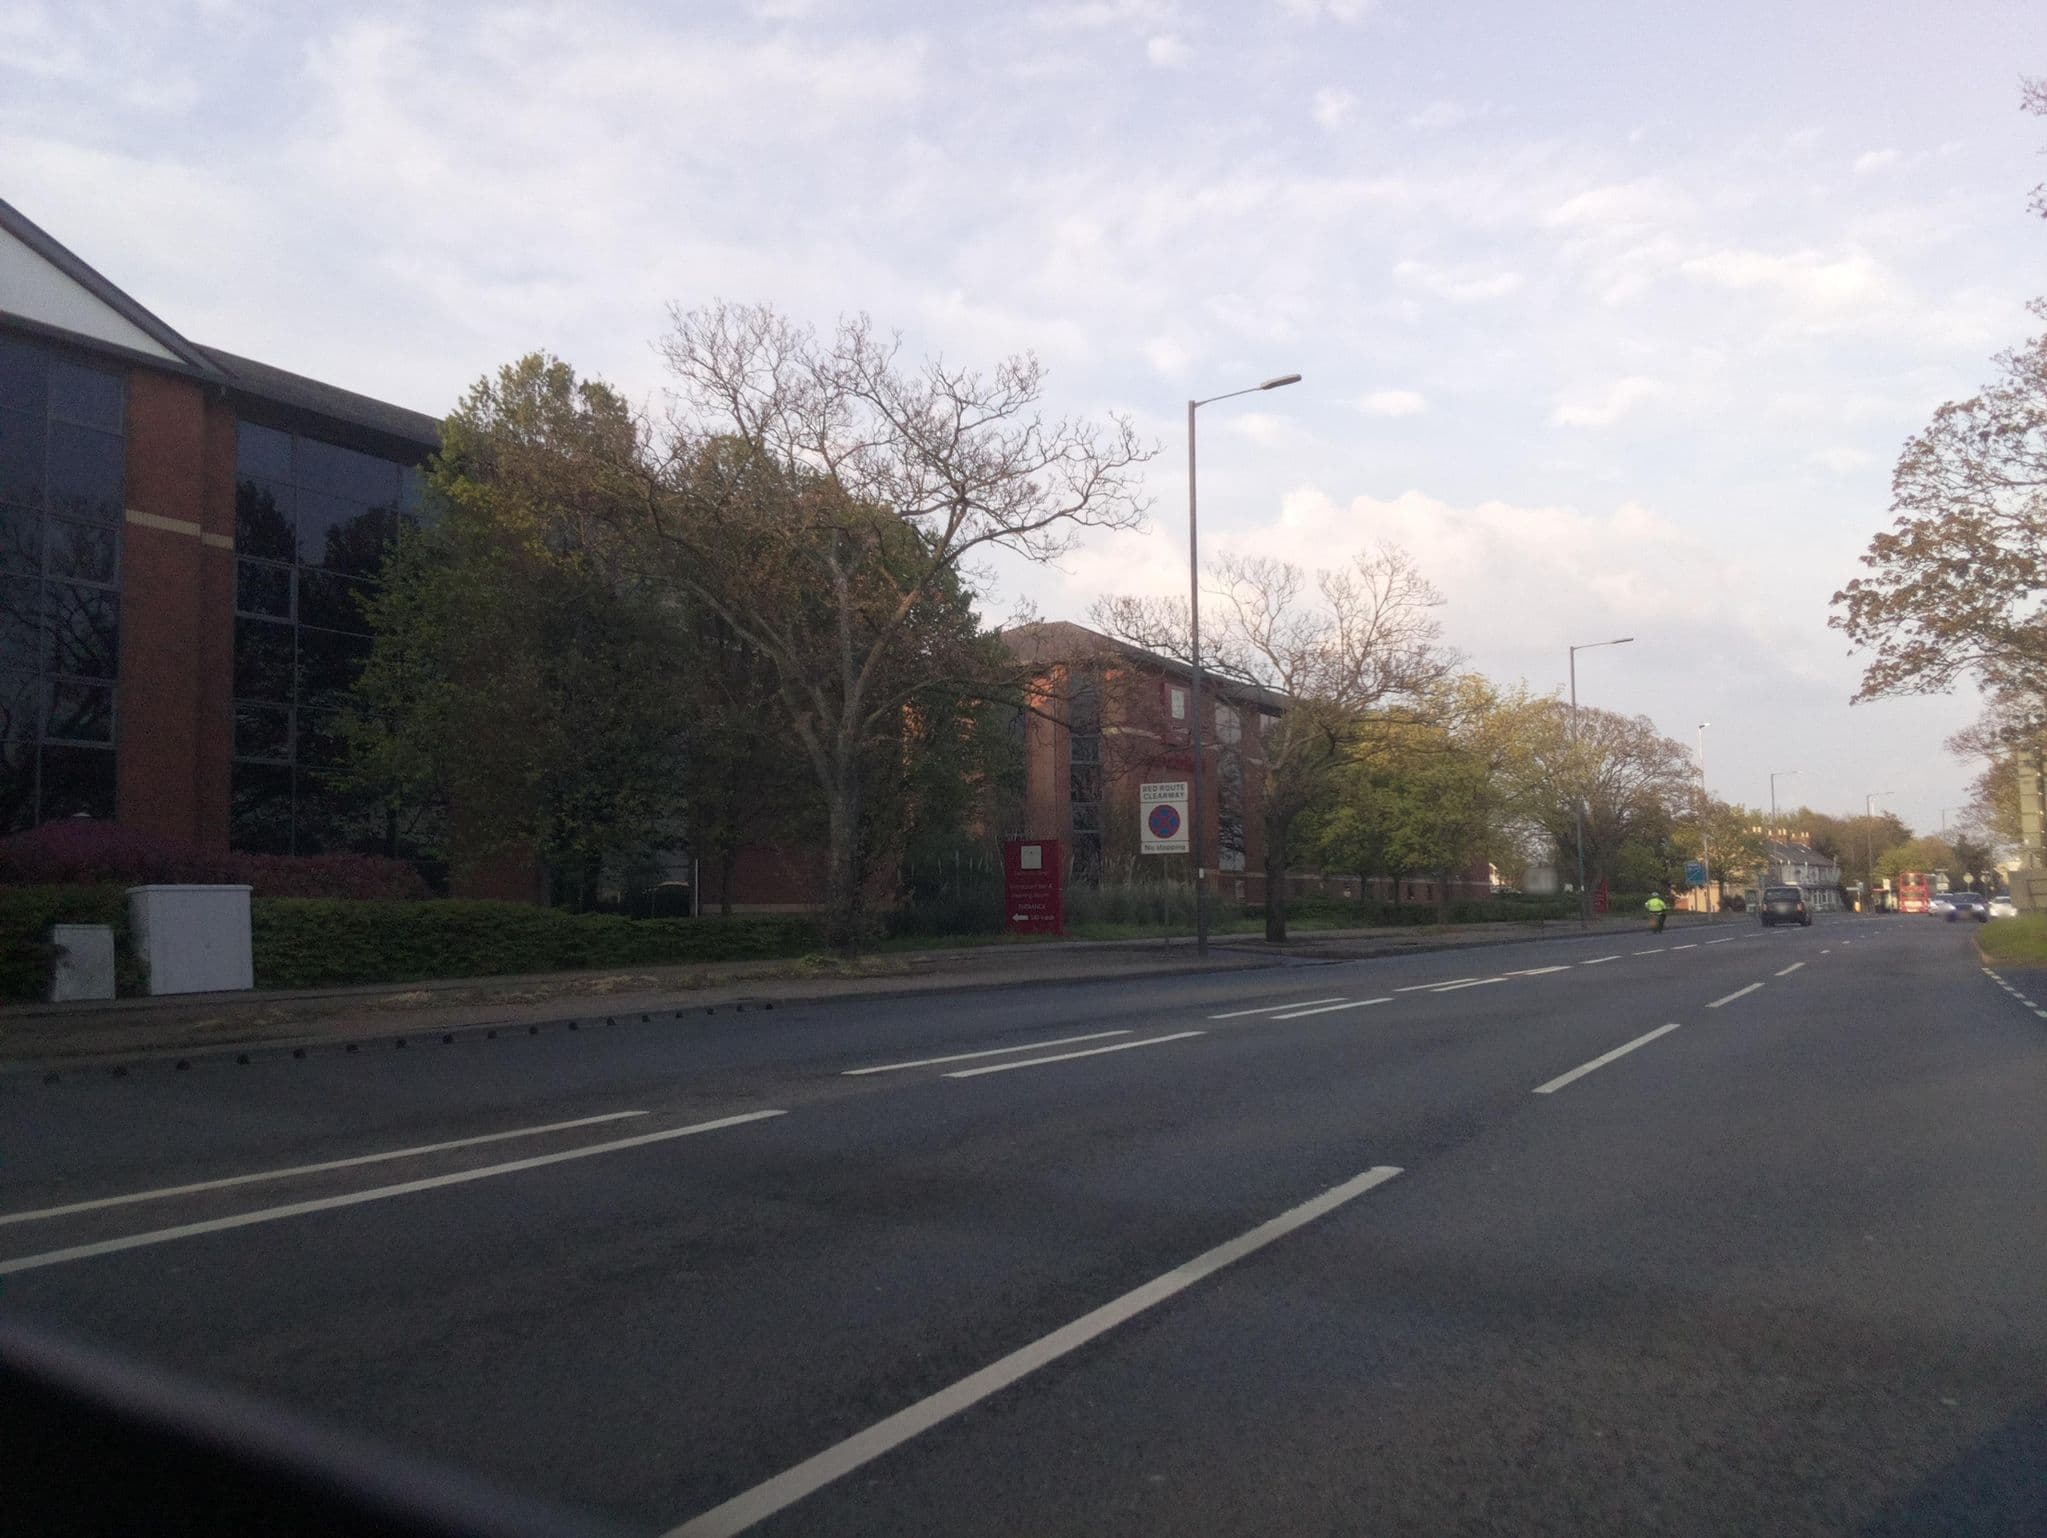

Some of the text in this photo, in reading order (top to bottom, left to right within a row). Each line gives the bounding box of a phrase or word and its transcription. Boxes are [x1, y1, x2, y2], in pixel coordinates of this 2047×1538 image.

[1143, 784, 1185, 793] RED ROUTE
[1144, 791, 1185, 800] CLEARWAY
